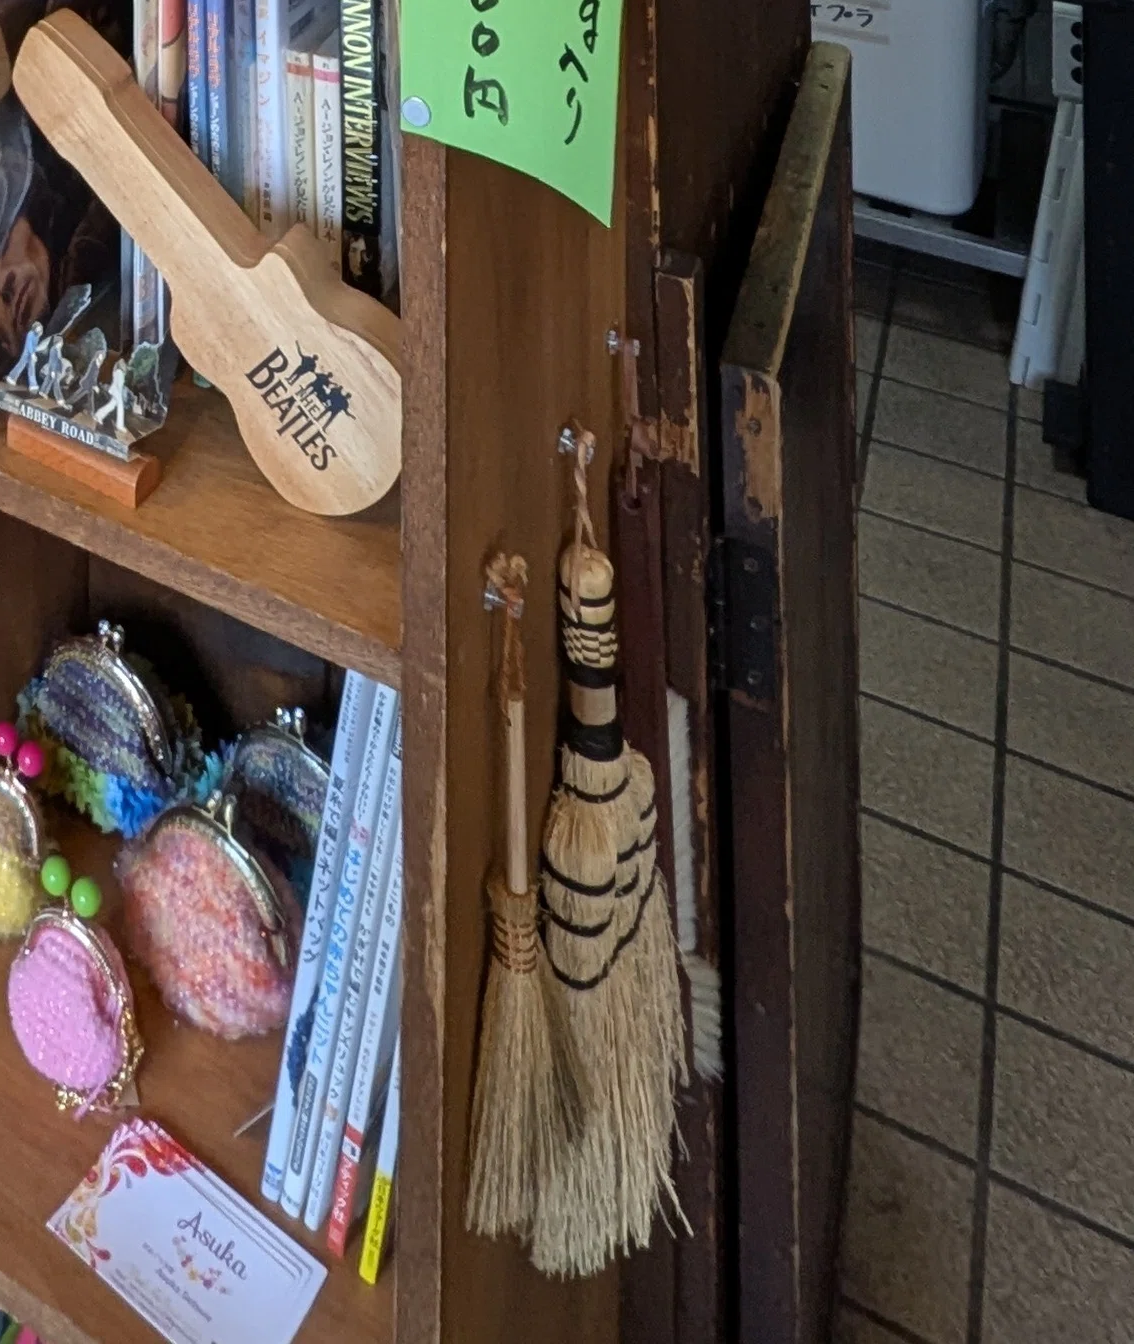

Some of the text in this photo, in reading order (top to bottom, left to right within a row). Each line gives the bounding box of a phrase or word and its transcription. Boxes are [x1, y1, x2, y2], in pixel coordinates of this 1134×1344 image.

[343, 70, 375, 224] INTERVIEWS
[18, 402, 96, 447] ABBEY ROAD
[244, 345, 338, 472] BEATLES
[296, 385, 323, 420] THE
[176, 1211, 247, 1281] Asuka
